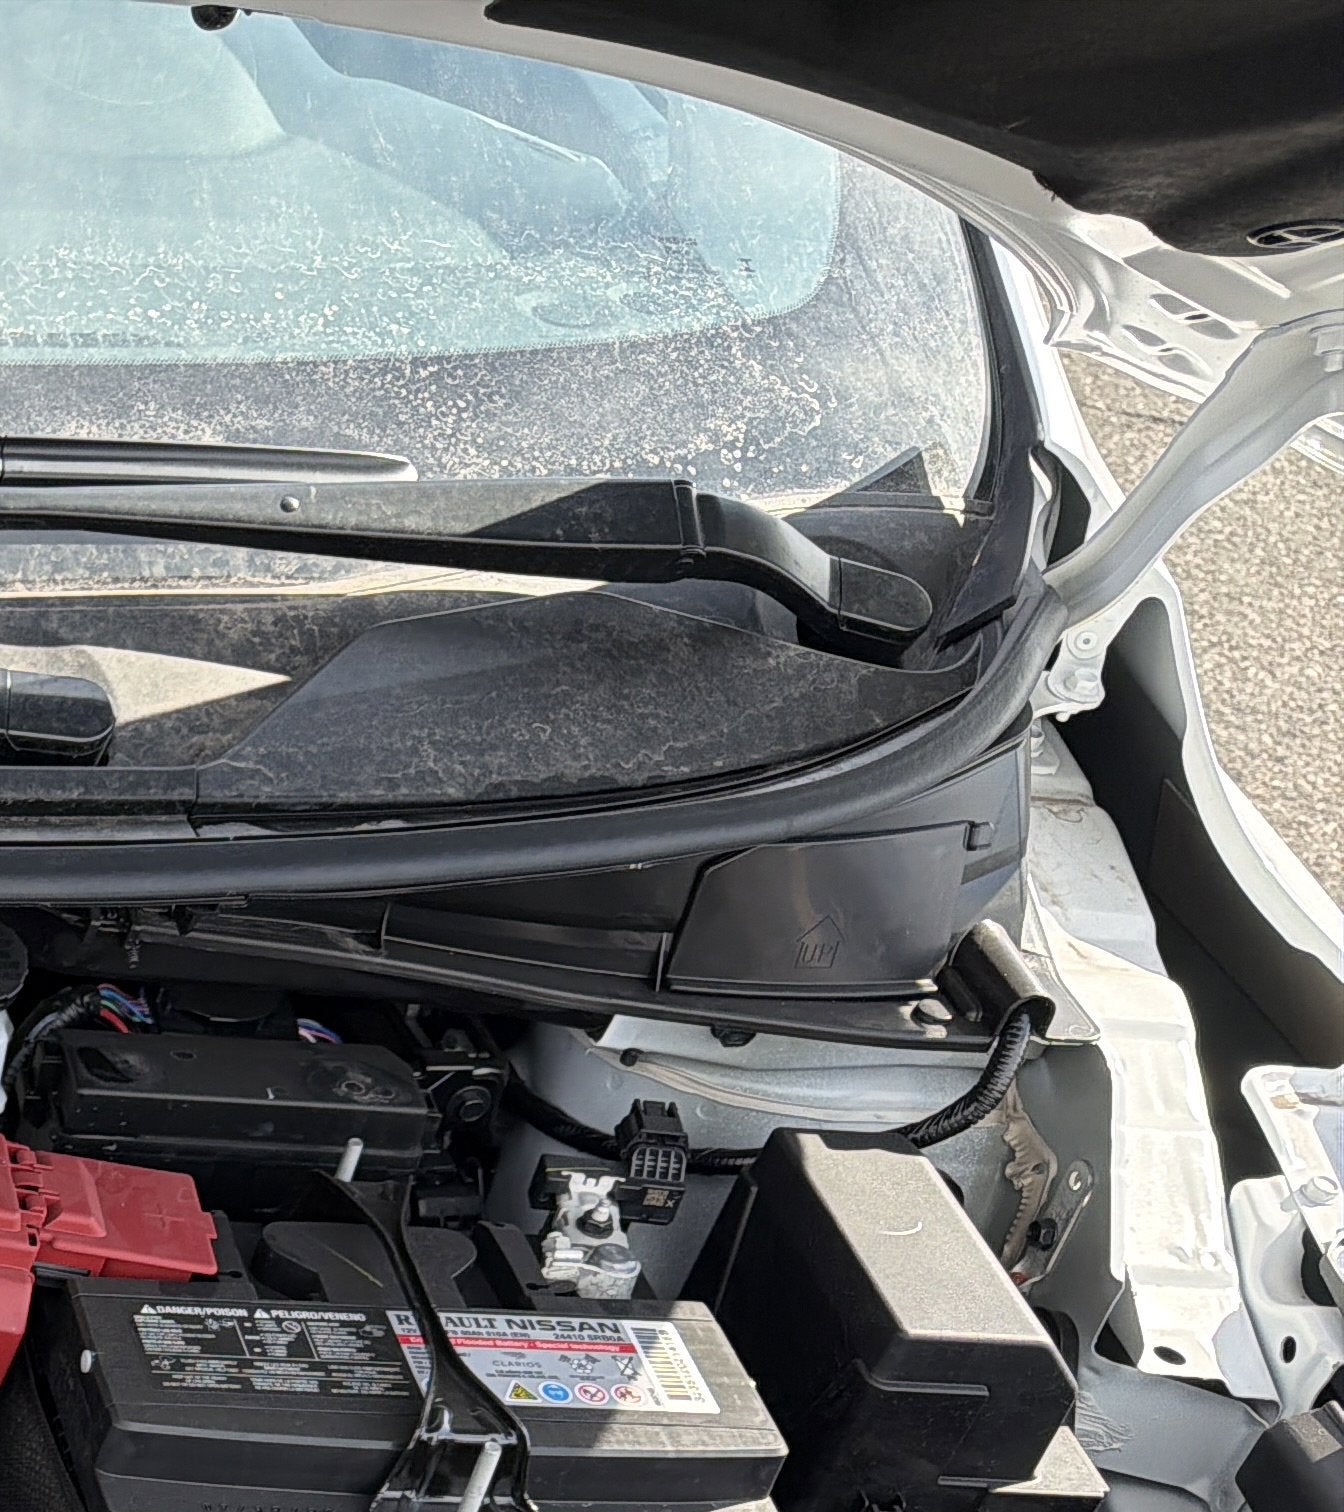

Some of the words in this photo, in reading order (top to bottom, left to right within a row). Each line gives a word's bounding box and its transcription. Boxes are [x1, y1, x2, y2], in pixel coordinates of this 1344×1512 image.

[155, 1305, 248, 1317] DANGER/POISON
[270, 1309, 367, 1321] PELIGRO/VENENO
[504, 1318, 621, 1334] NISSAN
[492, 1360, 542, 1368] CLARIOS
